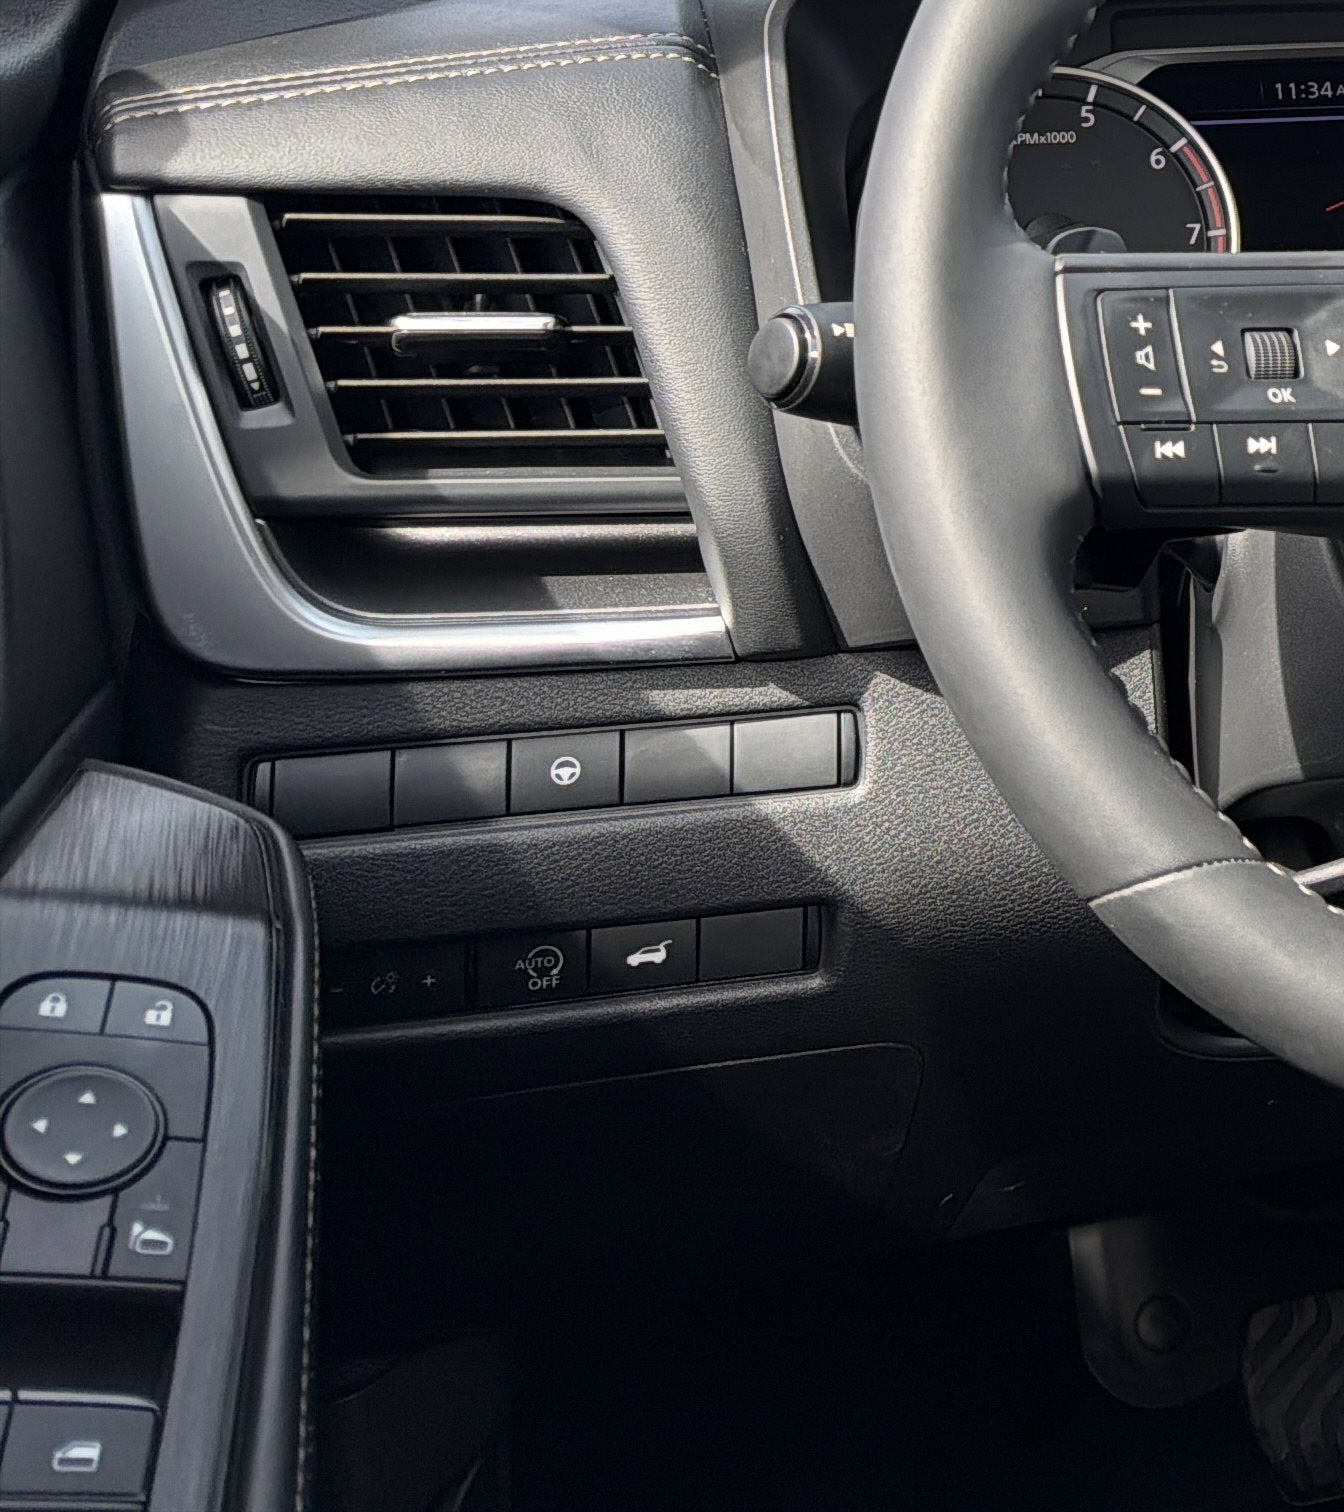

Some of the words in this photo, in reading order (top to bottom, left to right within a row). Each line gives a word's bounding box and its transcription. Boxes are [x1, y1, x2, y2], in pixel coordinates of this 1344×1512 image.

[1274, 81, 1334, 100] 11:34
[1080, 105, 1095, 128] 5
[1012, 130, 1077, 145] PMx1000
[1150, 147, 1166, 170] 6
[1185, 222, 1202, 245] 7
[1266, 387, 1297, 405] OK
[514, 956, 555, 970] AUTO
[528, 974, 561, 991] OFF
